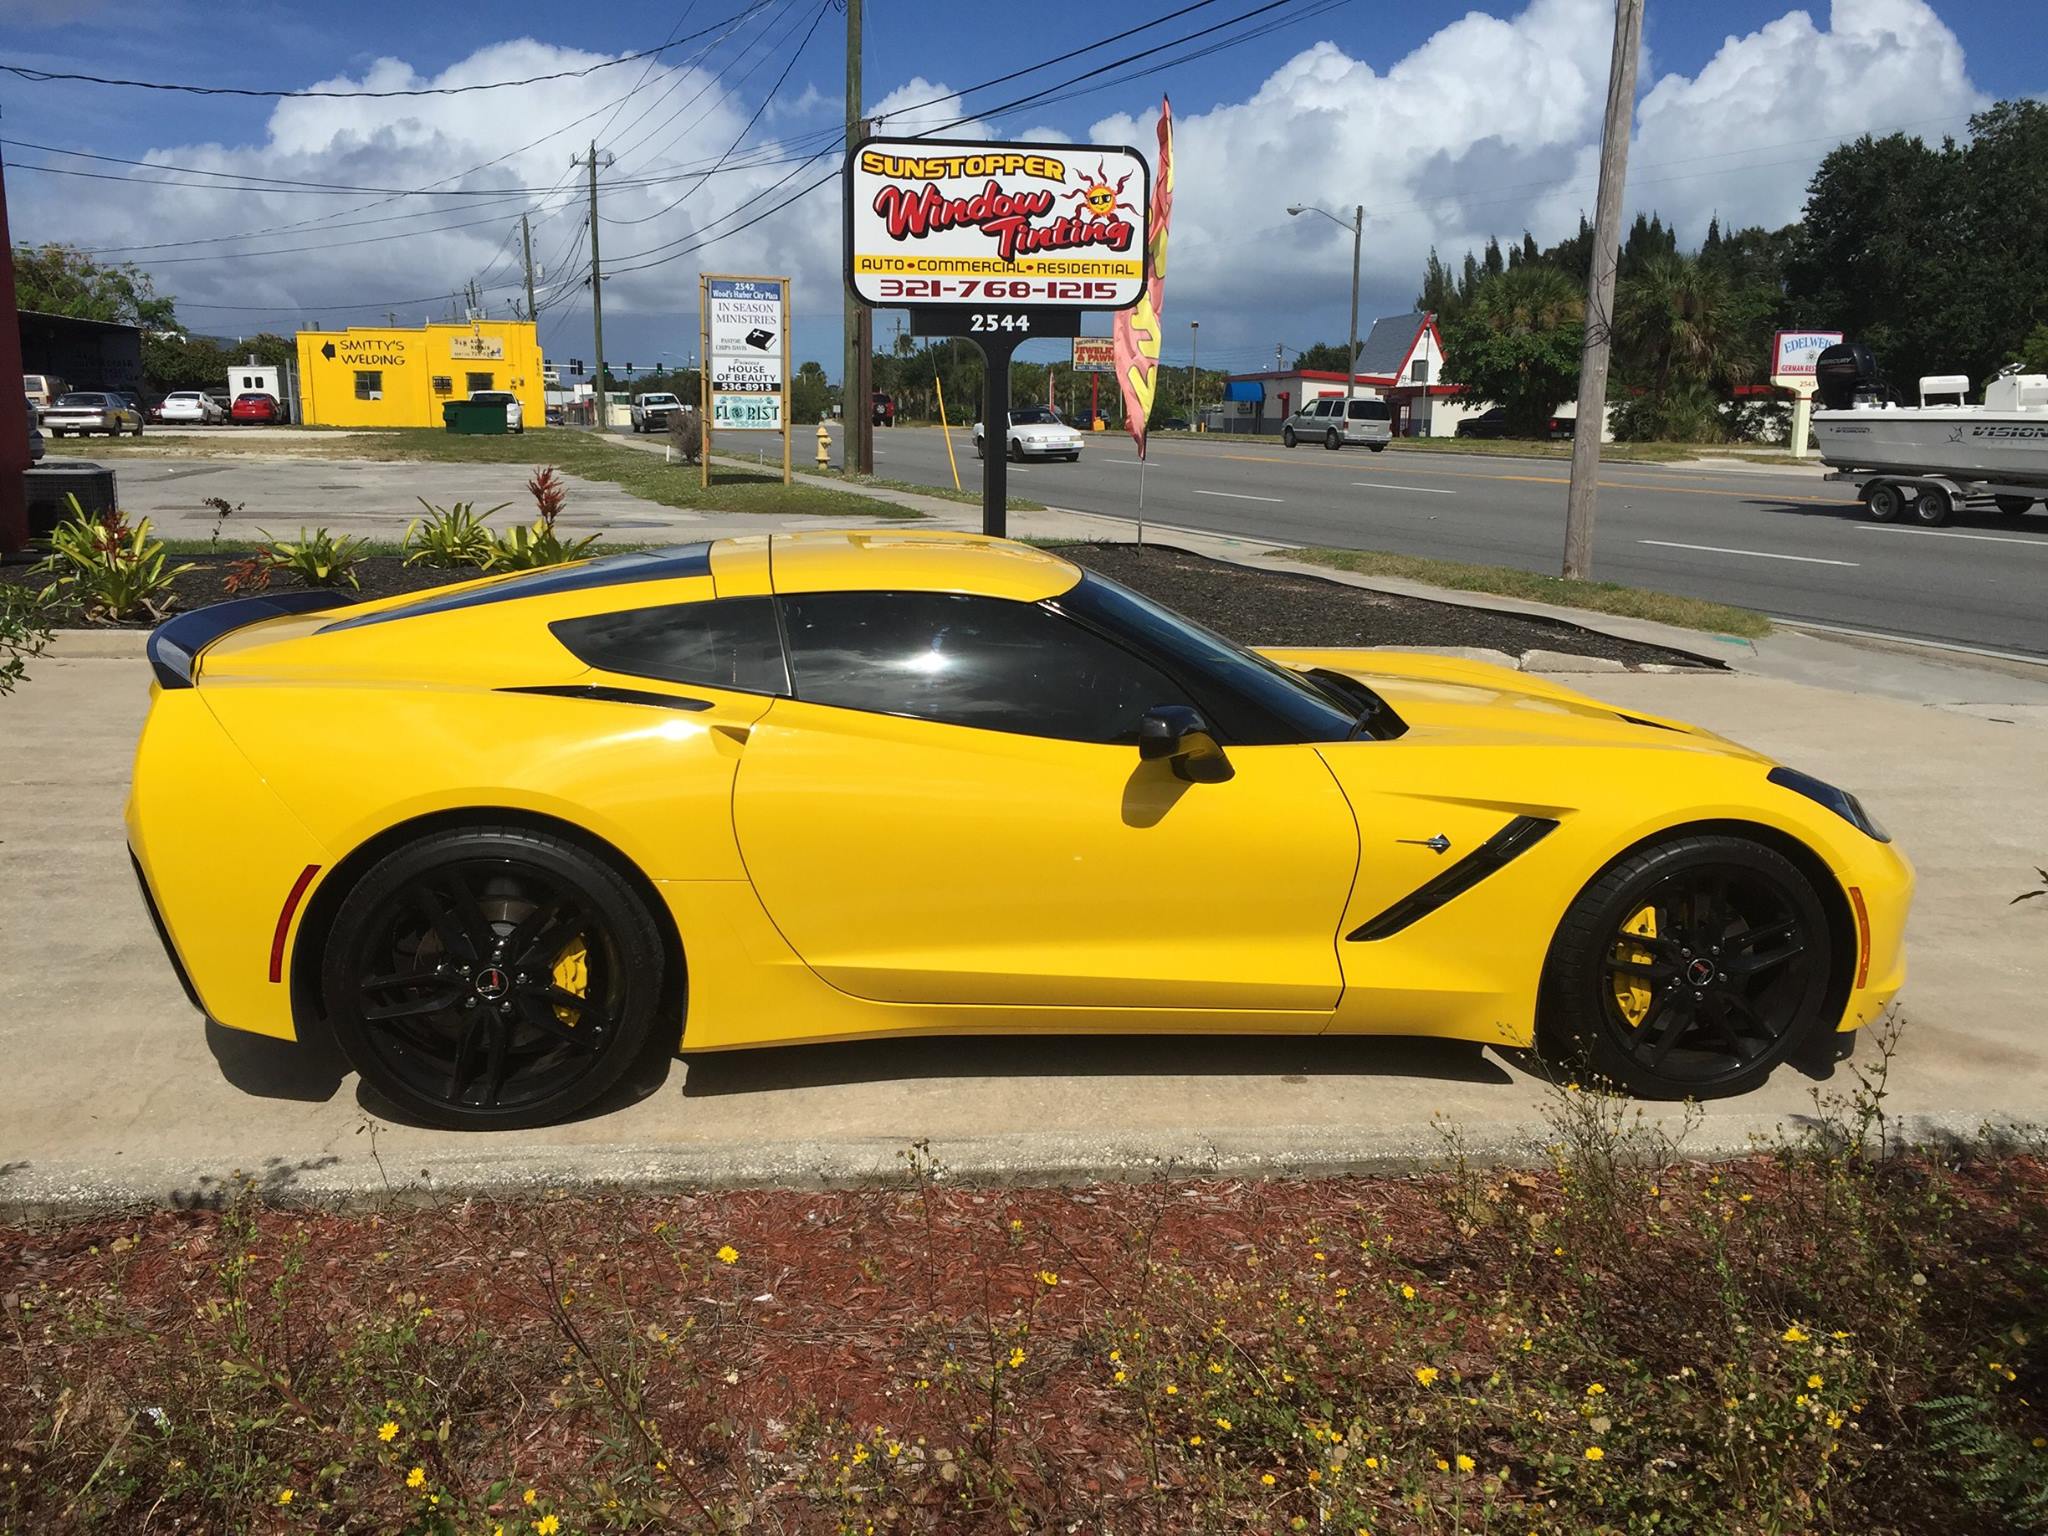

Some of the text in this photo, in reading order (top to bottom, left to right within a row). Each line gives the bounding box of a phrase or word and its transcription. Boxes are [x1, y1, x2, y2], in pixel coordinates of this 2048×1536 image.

[861, 150, 1066, 184] SUNSTOPPER
[873, 180, 1055, 240] Window
[979, 213, 1134, 262] Tinting
[861, 258, 1135, 275] AUTO COMMERCIAL RESIDENTIAL
[735, 282, 755, 291] 2542
[880, 280, 1117, 299] 321-768-1215
[718, 302, 774, 313] IN SEASON
[716, 314, 777, 325] MINISTRIES
[970, 314, 1030, 333] 2544
[339, 339, 405, 352] SMITTY'S
[341, 354, 406, 366] WELDING
[728, 365, 765, 374] HOUSE
[1781, 364, 1805, 373] GERMAN
[716, 373, 776, 382] OF BEAUTY
[721, 382, 772, 391] 536-8913
[1972, 426, 2048, 438] VISION
